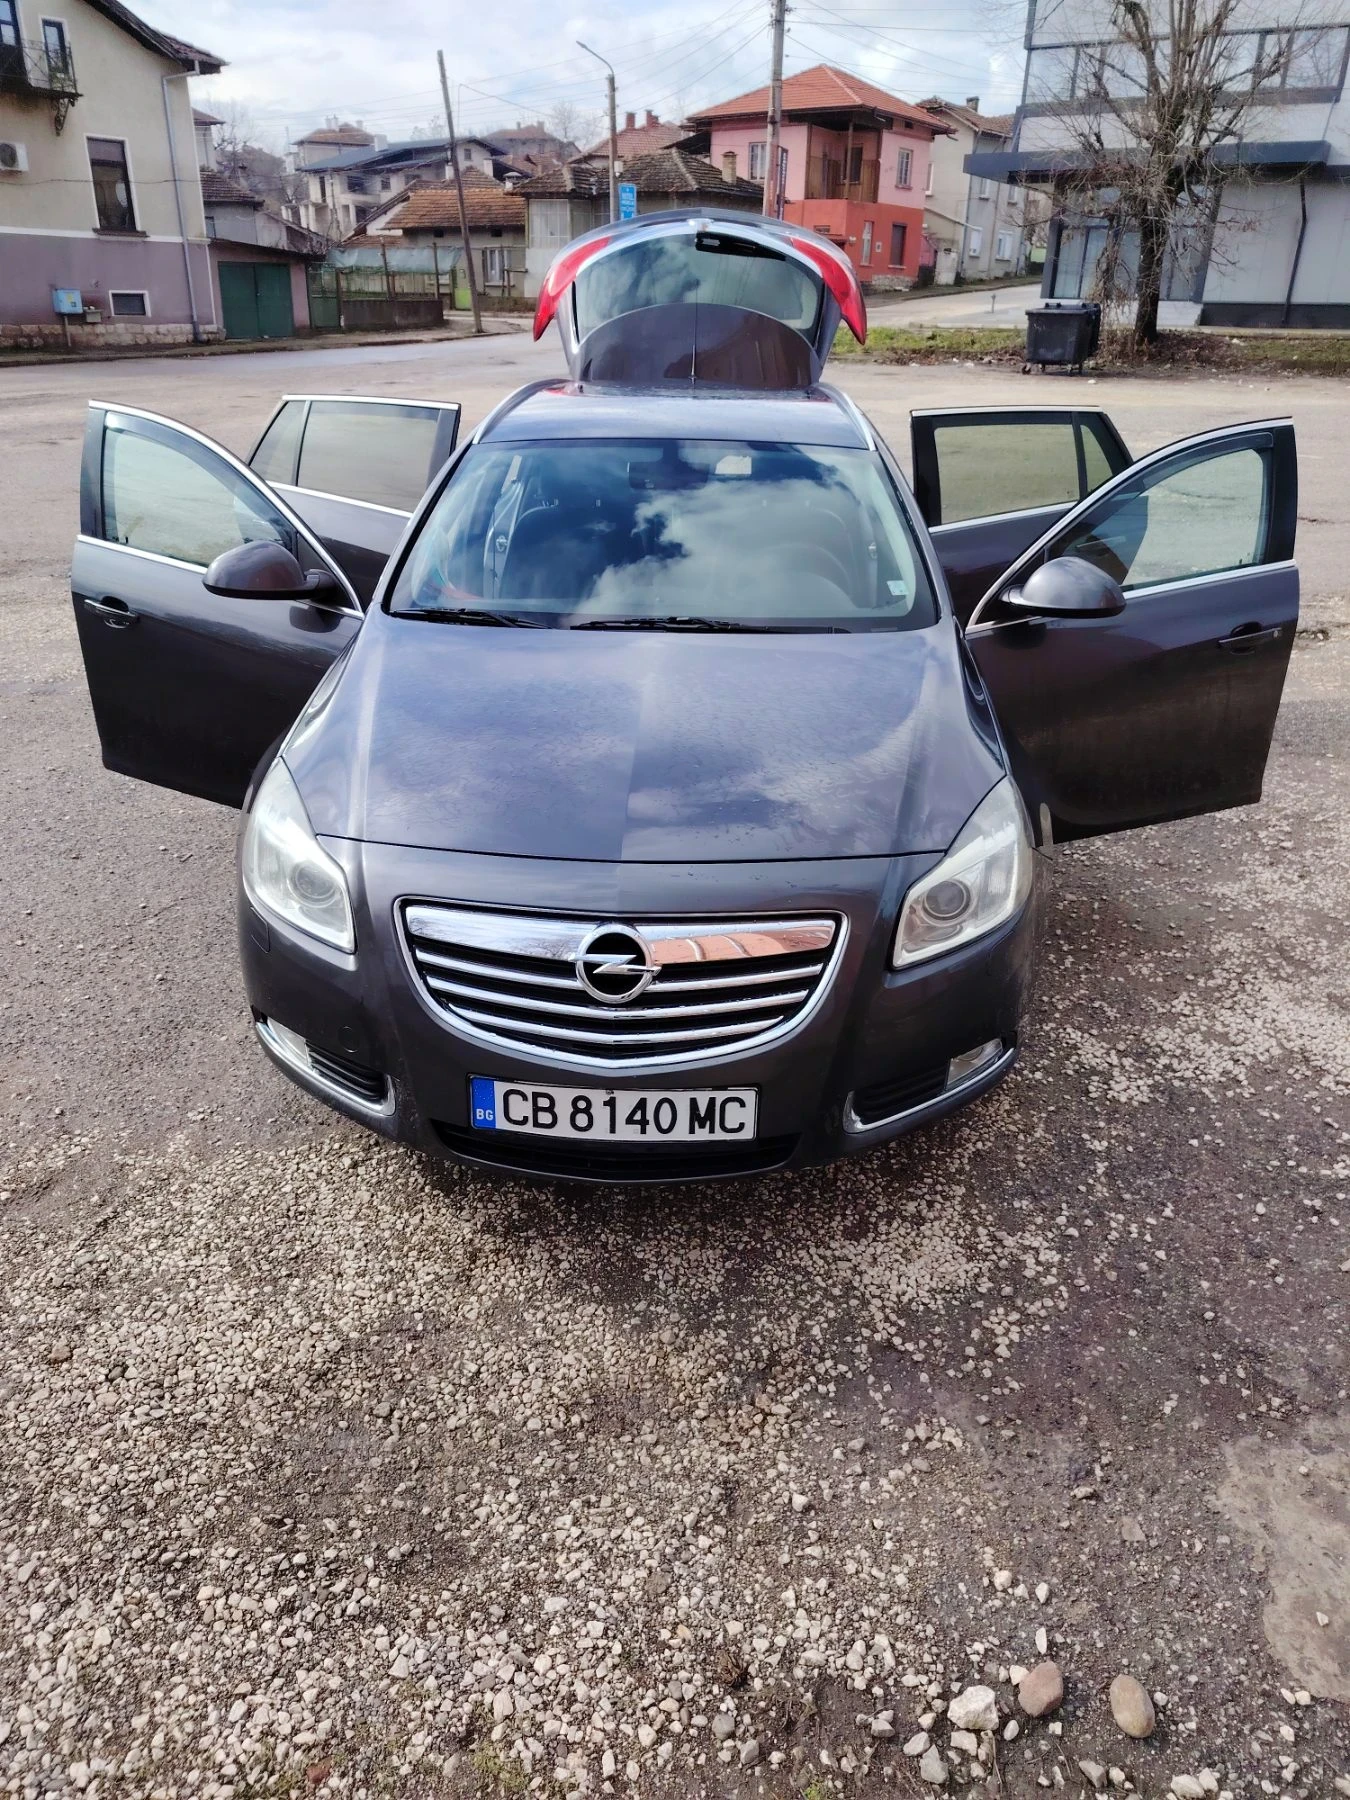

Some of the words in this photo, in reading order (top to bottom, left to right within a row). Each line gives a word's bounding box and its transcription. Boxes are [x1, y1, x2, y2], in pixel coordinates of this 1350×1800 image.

[476, 1108, 494, 1121] BG
[502, 1088, 558, 1129] CB
[569, 1094, 678, 1134] 8140
[688, 1096, 746, 1134] MC
